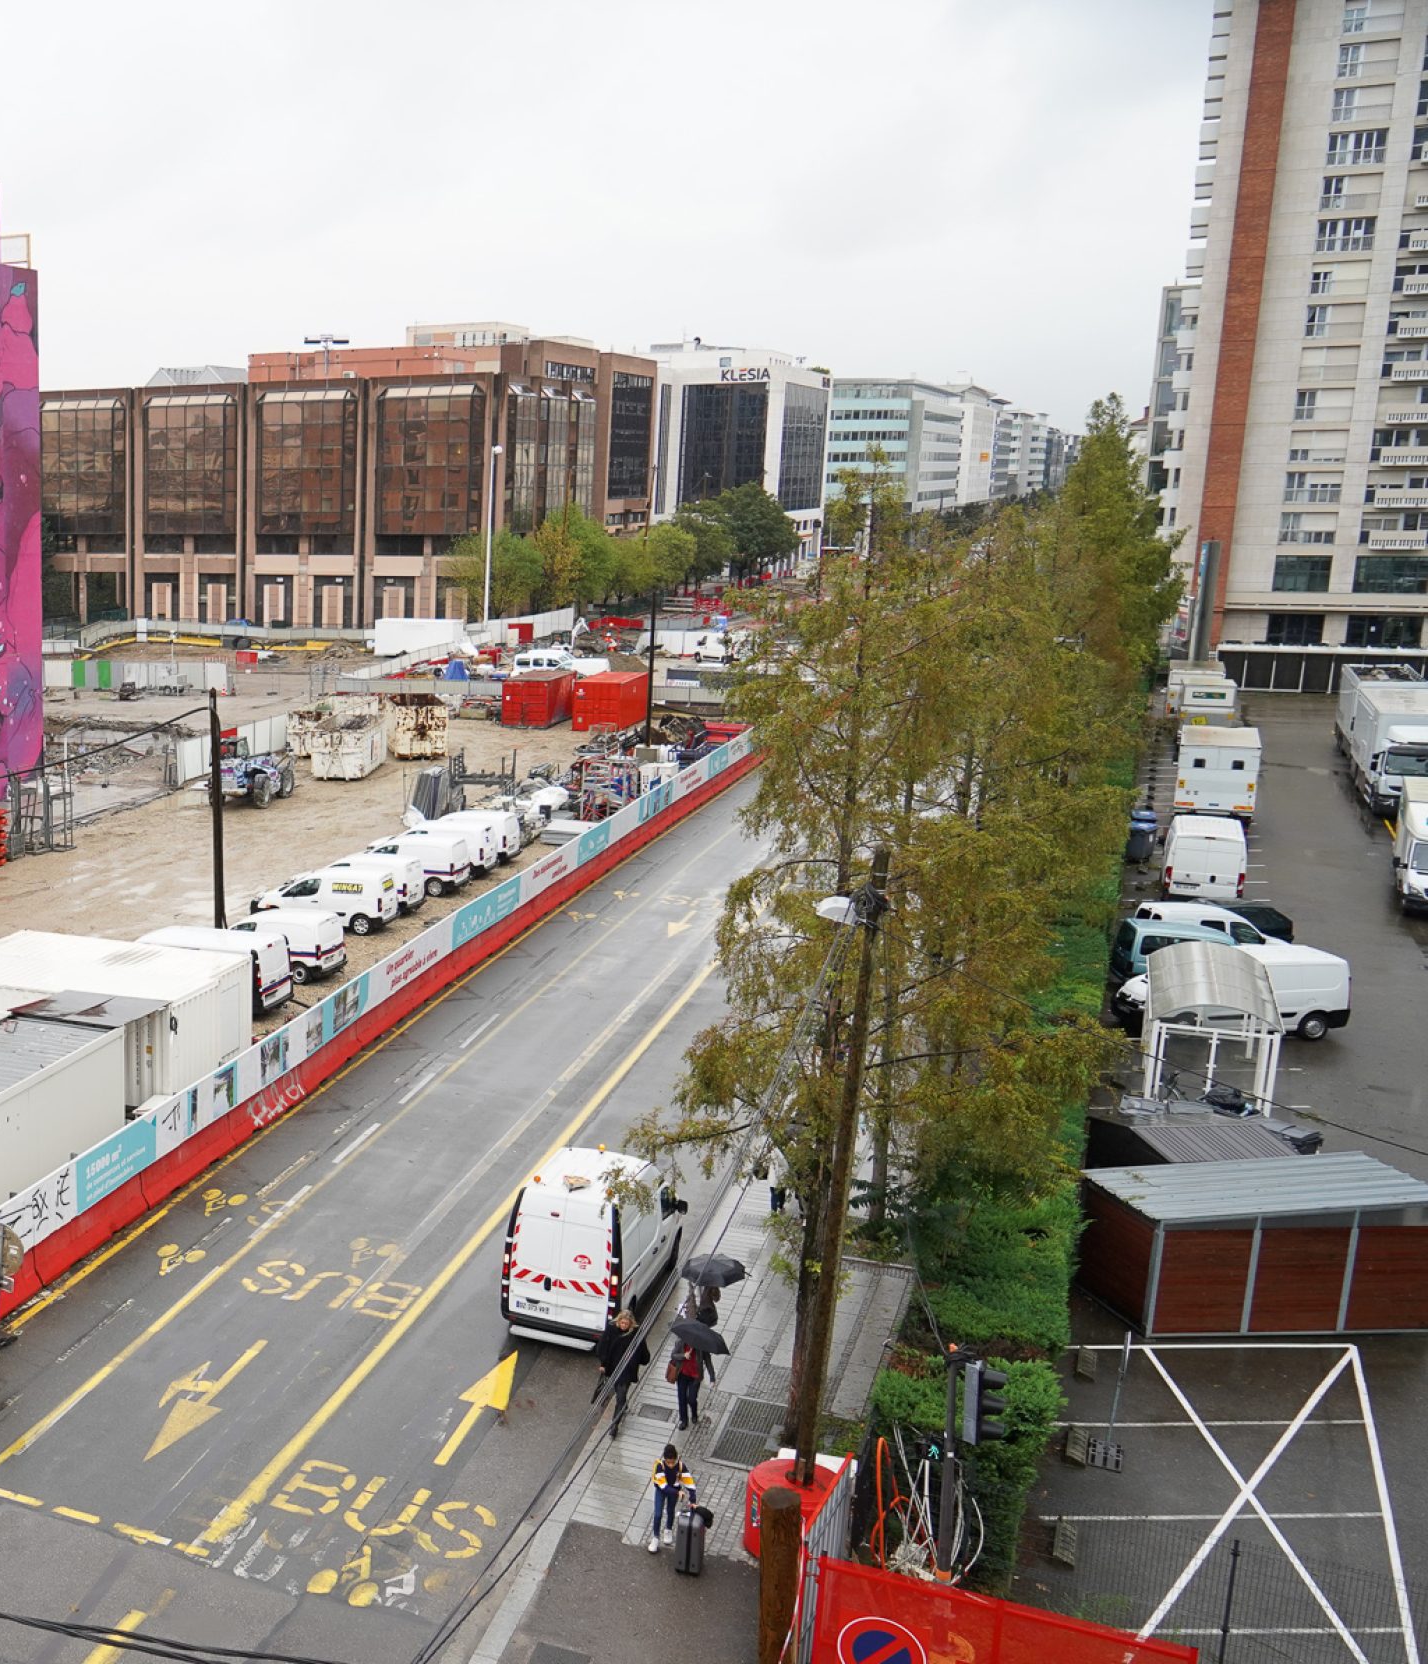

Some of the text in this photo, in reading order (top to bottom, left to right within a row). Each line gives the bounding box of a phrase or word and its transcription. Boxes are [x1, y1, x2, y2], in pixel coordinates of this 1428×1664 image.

[721, 367, 770, 381] KLESIA
[394, 949, 414, 971] quartier
[240, 1259, 423, 1321] BUS
[270, 1459, 497, 1559] BUS
